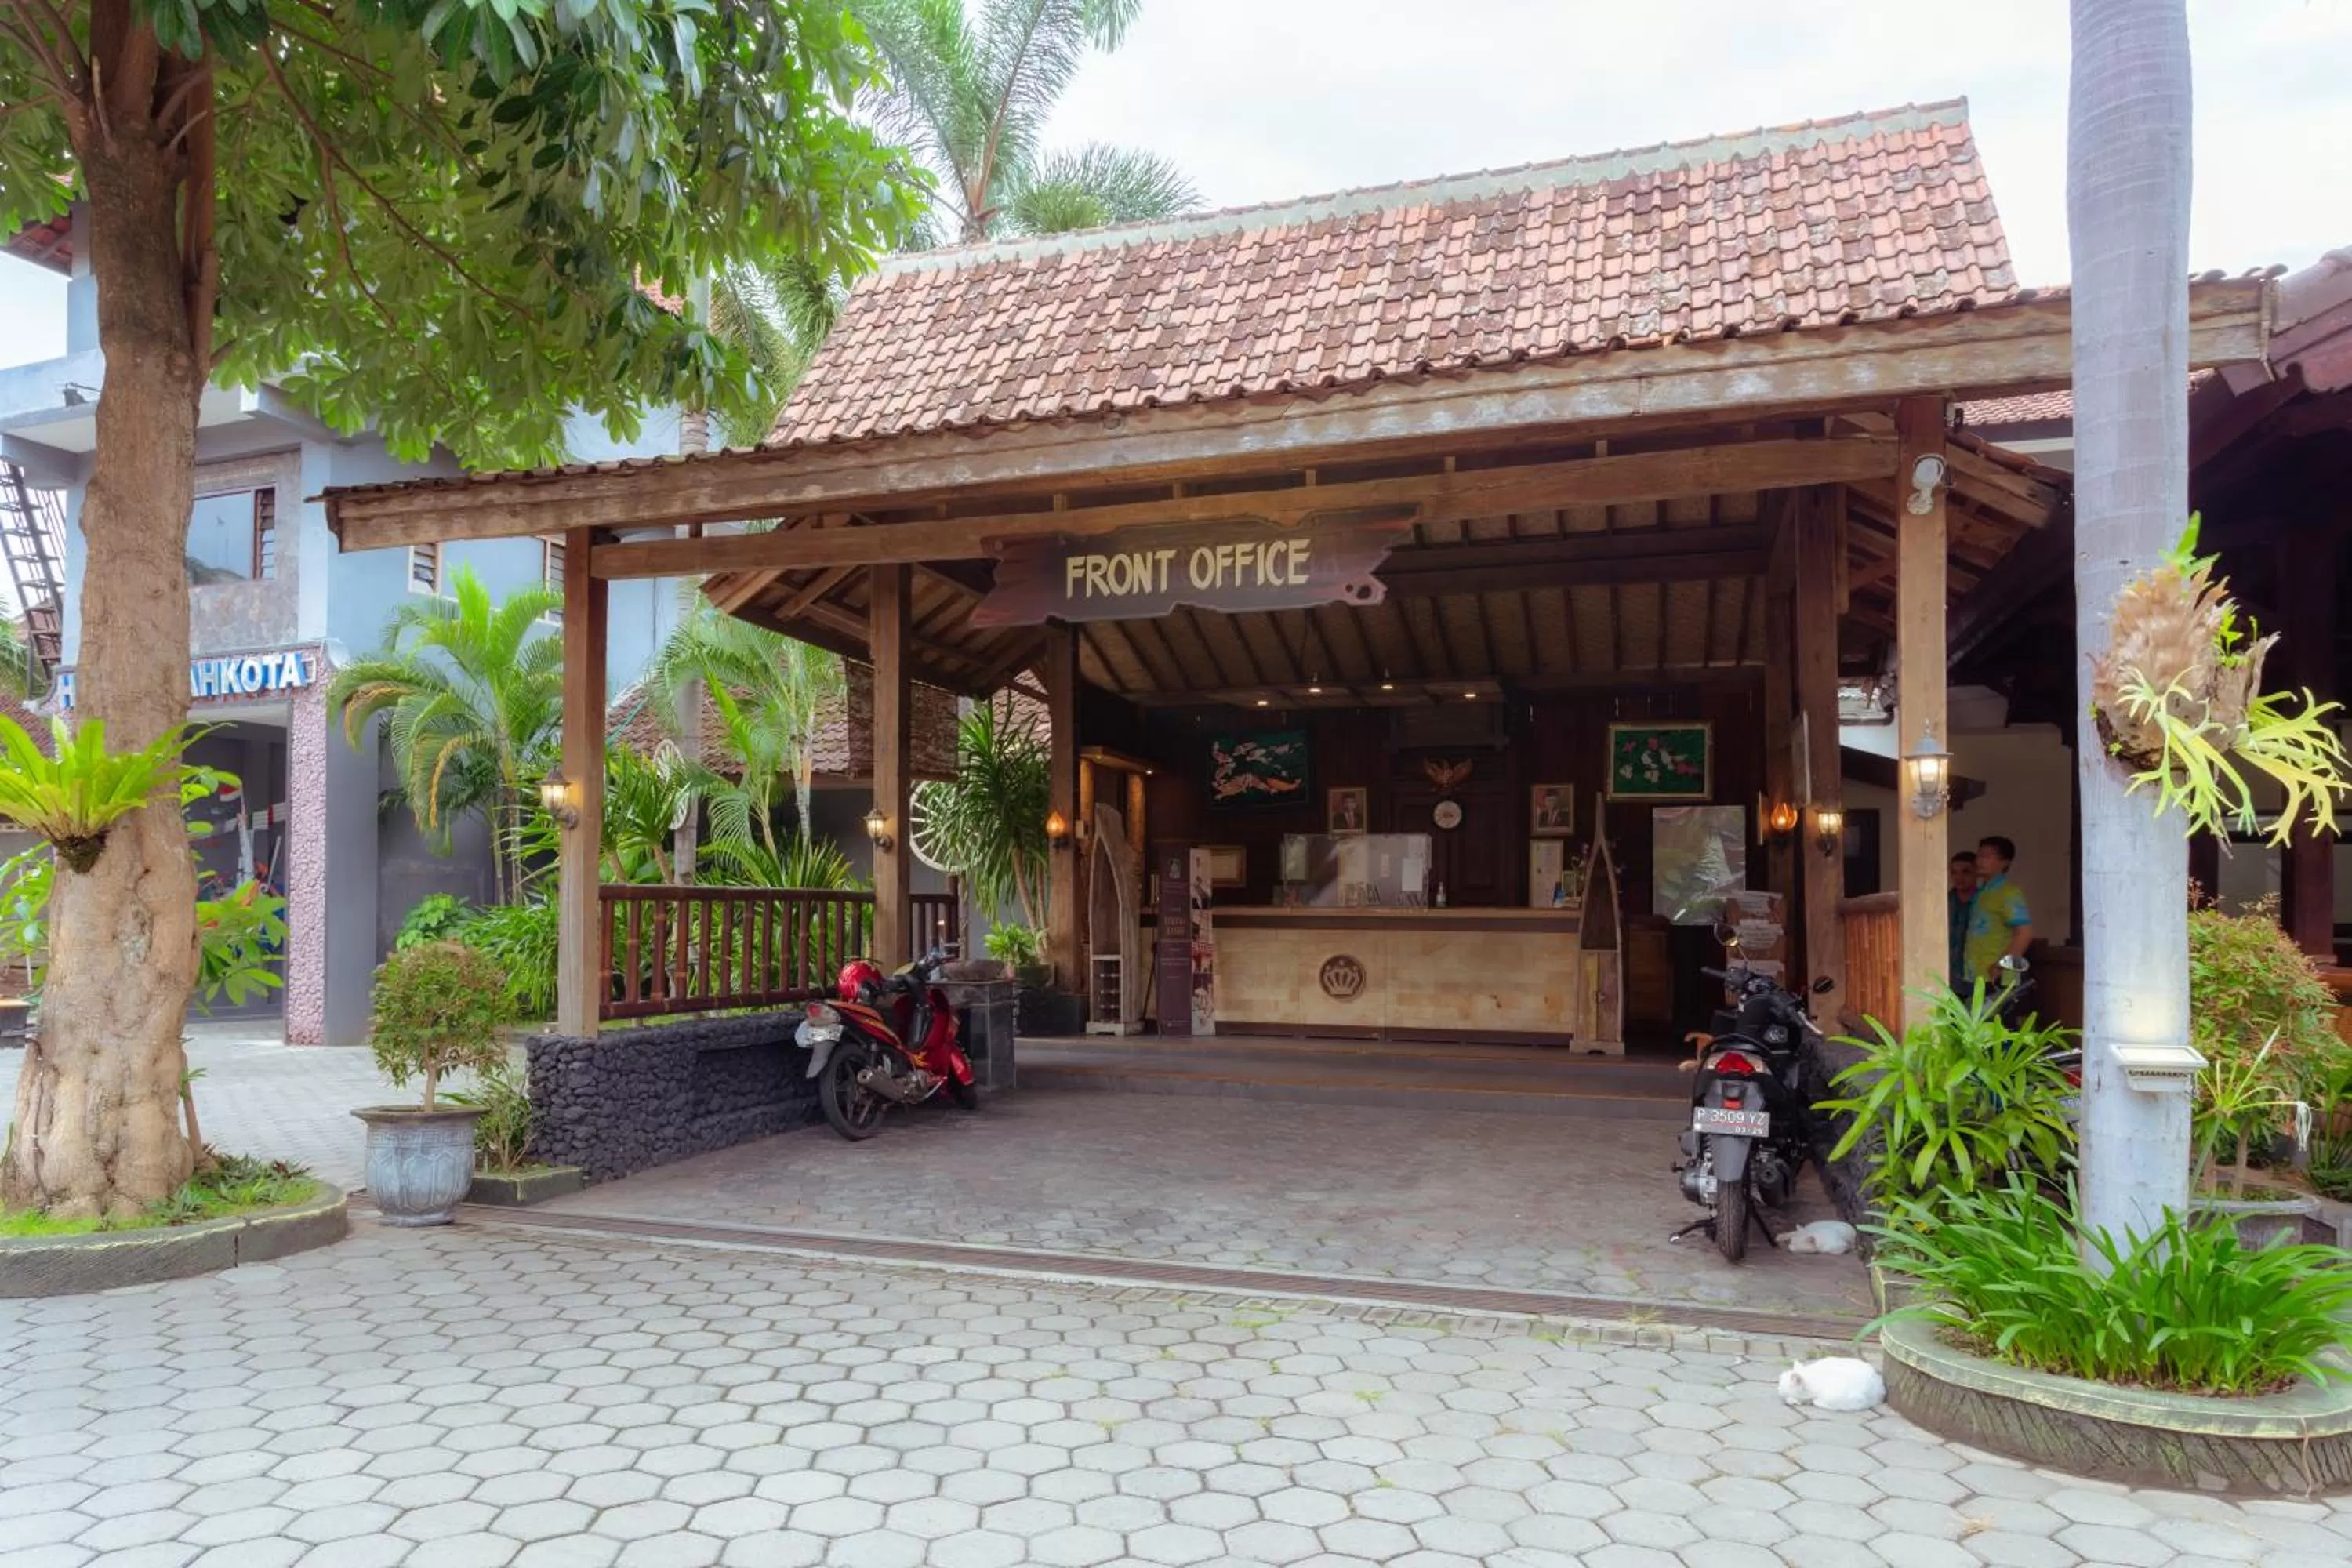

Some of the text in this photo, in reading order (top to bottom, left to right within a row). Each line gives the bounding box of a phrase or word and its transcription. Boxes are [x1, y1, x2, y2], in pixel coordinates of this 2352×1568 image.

[1066, 539, 1311, 600] FRONT OFFICE
[1711, 1109, 1744, 1123] 3509
